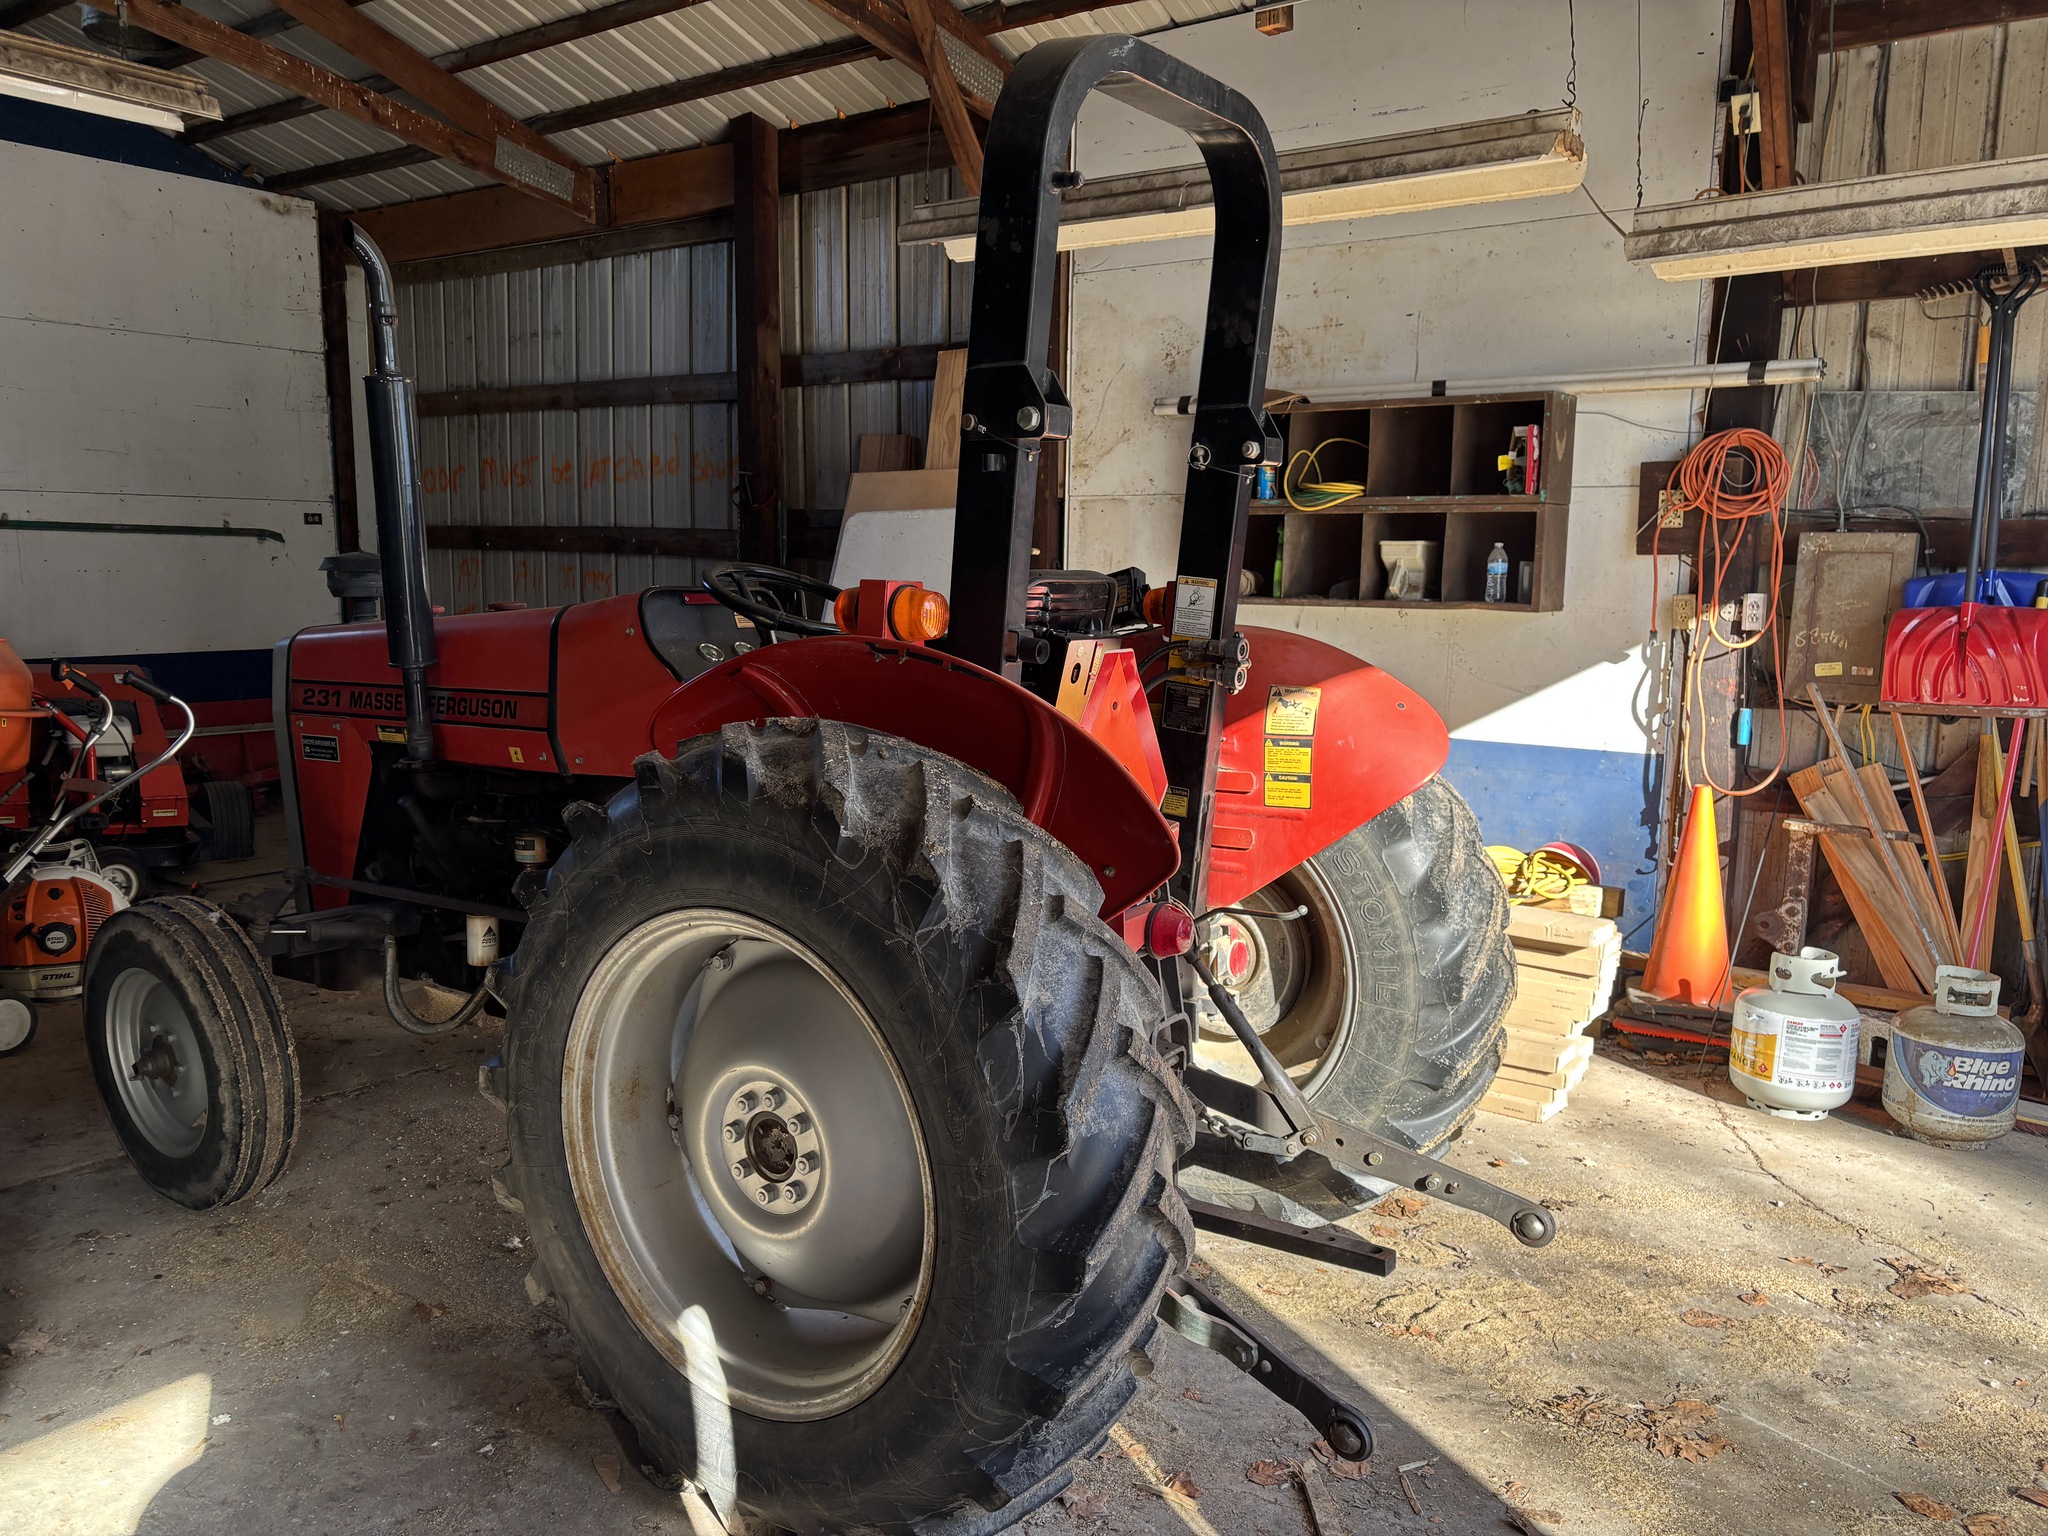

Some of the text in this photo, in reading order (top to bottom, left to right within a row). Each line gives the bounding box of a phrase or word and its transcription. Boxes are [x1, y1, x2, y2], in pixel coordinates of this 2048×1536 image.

[422, 464, 466, 496] oor
[551, 448, 573, 486] be
[302, 688, 519, 720] 231 MASSE FERGUSON
[1172, 788, 1188, 796] CAUTION
[1331, 847, 1401, 1003] STOMIL
[40, 972, 75, 981] STIHL
[1731, 1031, 1757, 1061] NE
[1953, 1056, 2011, 1076] Blue
[1943, 1073, 2017, 1092] Rhino
[1980, 1091, 1988, 1099] by
